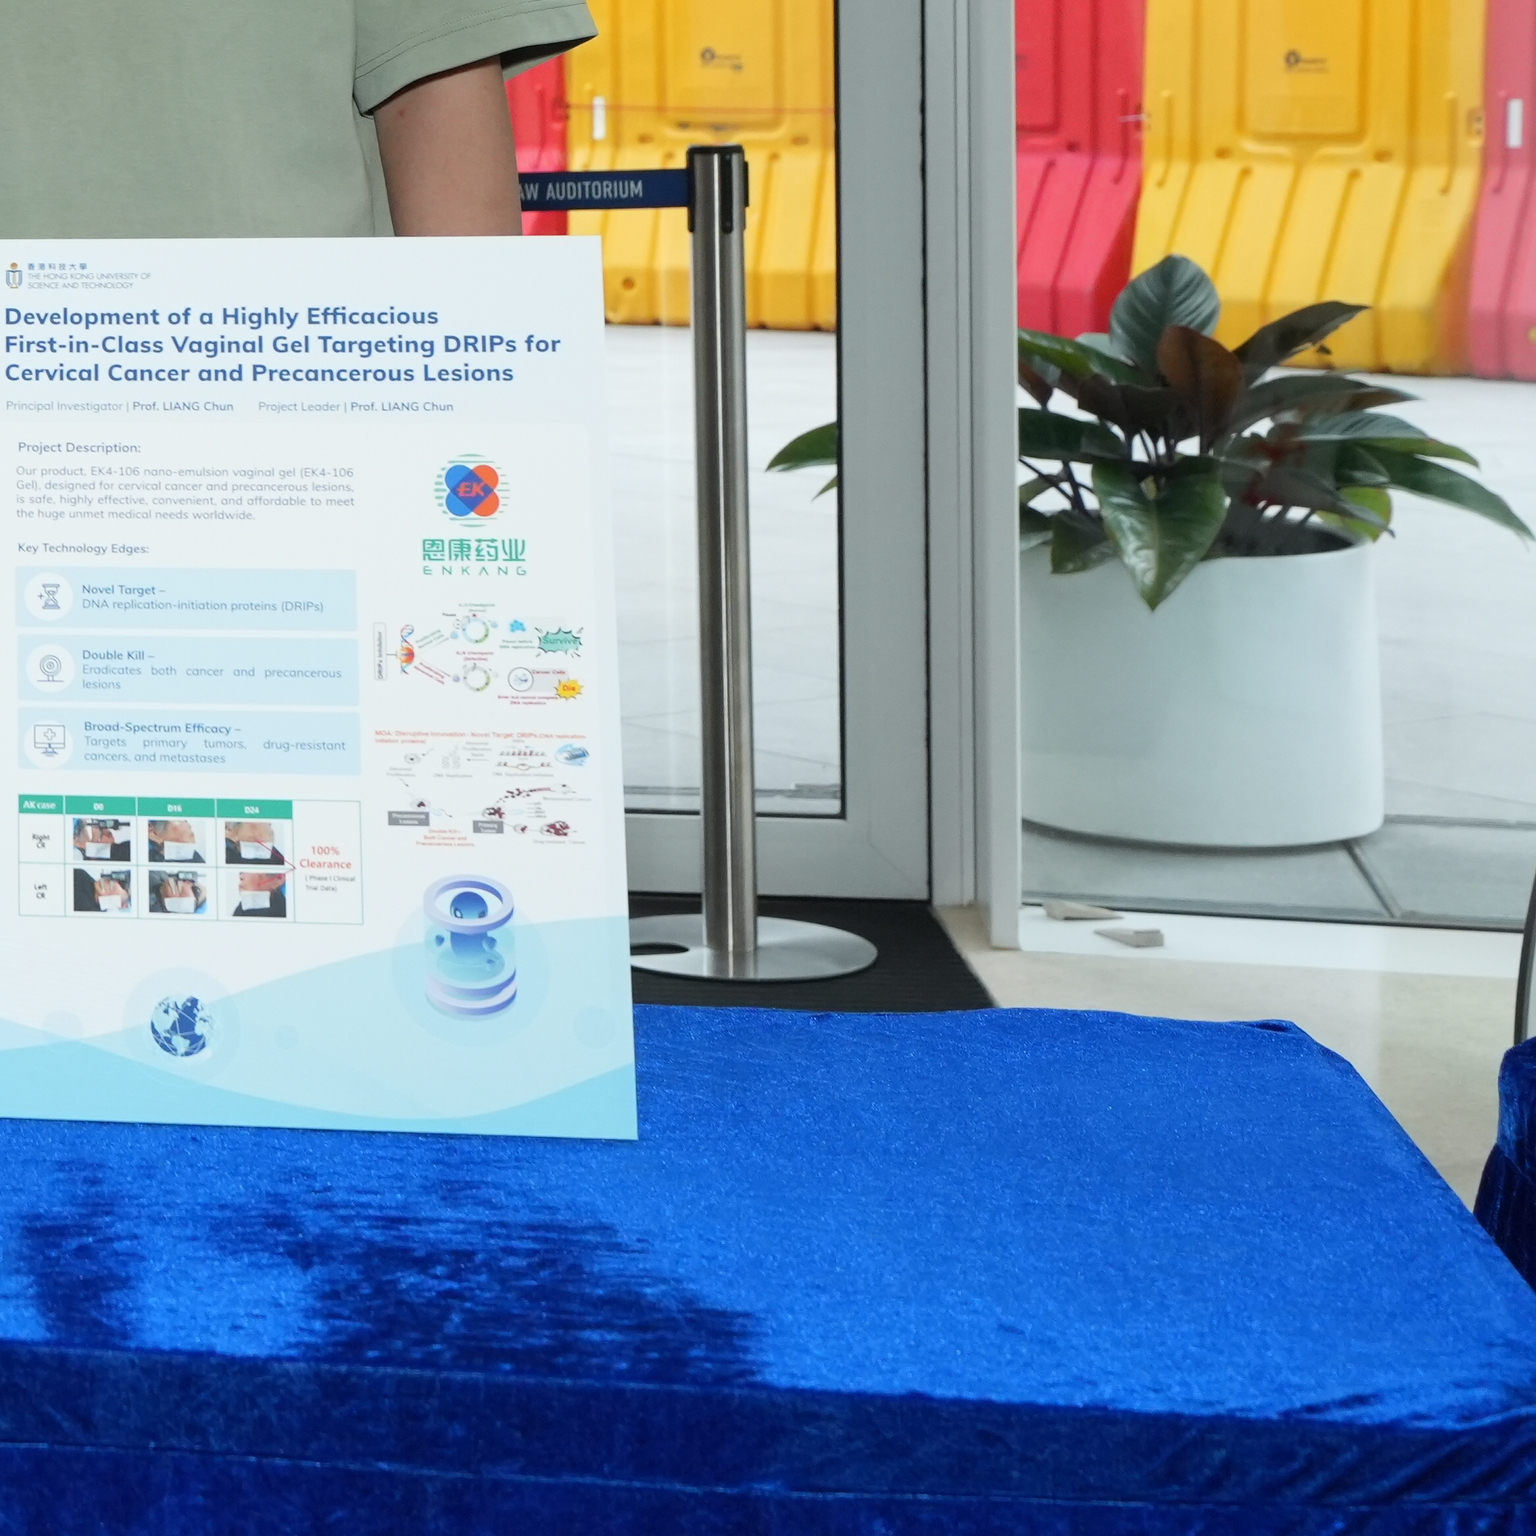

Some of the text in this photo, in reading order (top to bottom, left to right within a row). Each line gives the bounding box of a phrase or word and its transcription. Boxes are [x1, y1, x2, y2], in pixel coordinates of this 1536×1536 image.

[546, 180, 643, 201] AUDITORIUM
[6, 306, 438, 330] Development of a Highly Efficacious
[6, 334, 560, 358] First-in-Class Vaginal Gel Targeting DRIPs for
[6, 363, 513, 382] Cervical Cancer and Precancerous Lesions
[6, 400, 233, 414] Principal Investigator Prof. LIANG Chun
[259, 401, 453, 414] Project Leader Prof. LIANG Chun
[19, 441, 140, 455] Project Description:
[16, 465, 354, 480] Our product, EK4-106 nano-emulsion vaginal gel (EK4-106
[18, 542, 148, 556] Key Technology Edges:
[423, 538, 525, 562] 恩康药业
[423, 565, 526, 576] ENKANG
[83, 584, 155, 597] Novel Target
[83, 598, 323, 613] DNA replication-initiation proteins (DRIPs)
[83, 650, 144, 660] Double Kill
[83, 664, 342, 679] Eradicates both cancer and precancerous
[83, 679, 121, 690] lesions
[85, 721, 231, 736] Broad-Spectrum Efficacy
[85, 735, 345, 752] Targets primary tumors, drug-resistant
[84, 752, 225, 764] cancers, and metastases
[312, 846, 340, 856] 100%
[300, 858, 351, 869] Clearance
